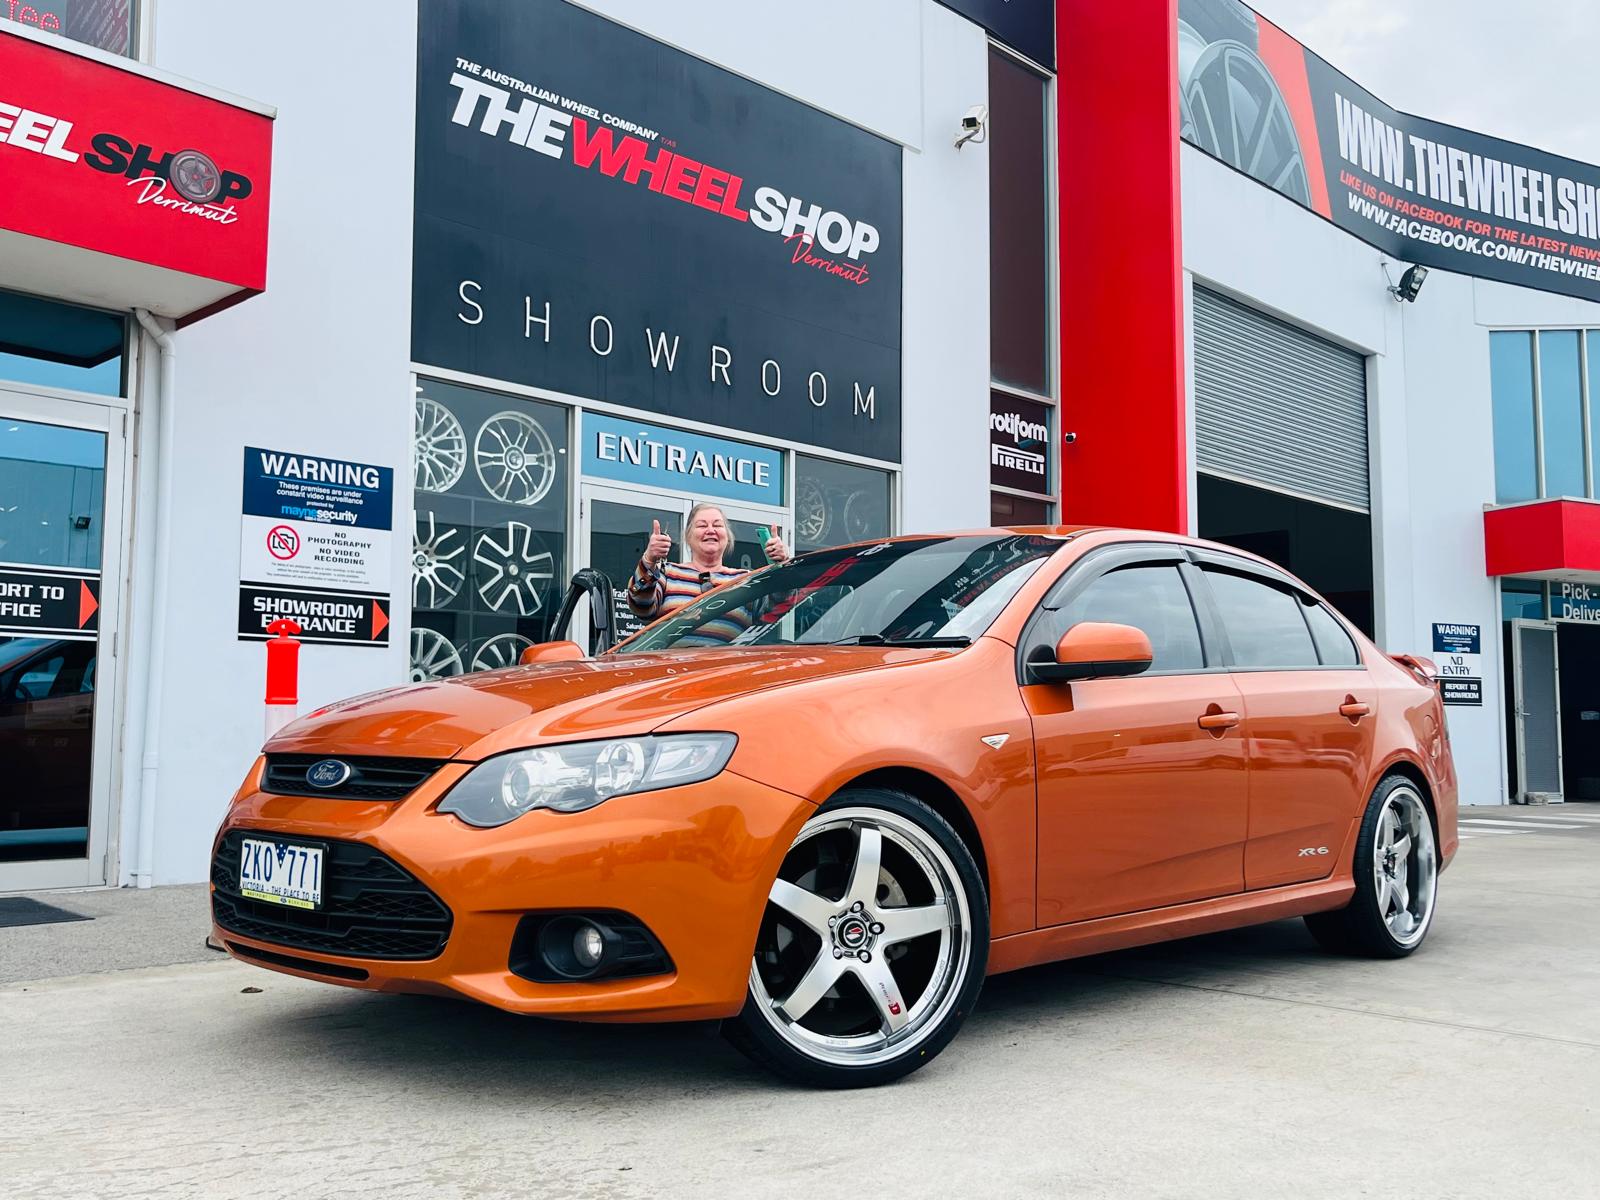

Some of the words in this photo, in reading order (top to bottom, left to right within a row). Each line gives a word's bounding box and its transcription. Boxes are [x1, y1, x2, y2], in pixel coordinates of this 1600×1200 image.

[456, 57, 482, 76] THE
[481, 67, 560, 106] AUSTRALIAN
[561, 97, 600, 120] WHEEL
[602, 113, 659, 141] COMPANY
[450, 72, 573, 160] THE
[573, 116, 749, 222] WHEEL
[750, 186, 880, 260] SHOP
[1335, 92, 1600, 240] WWW.THEWHEELSH
[126, 176, 238, 224] Derrimut
[1339, 170, 1362, 194] LIKE
[1362, 181, 1378, 200] US
[1379, 190, 1394, 208] ON
[1395, 198, 1464, 230] FACEBOOK
[1465, 220, 1491, 237] FOR
[1494, 226, 1519, 243] THE
[1520, 233, 1568, 254] LATEST
[784, 233, 869, 285] Derrimut
[990, 412, 1048, 442] rotiform
[597, 431, 770, 488] ENTRANCE
[991, 443, 1045, 475] PIRELLI
[260, 452, 380, 489] WARNING
[276, 489, 306, 499] constant
[306, 492, 325, 501] video
[325, 495, 364, 505] surveillance
[278, 481, 299, 491] These
[300, 484, 331, 495] premises
[331, 488, 342, 496] are
[343, 490, 363, 498] under
[307, 537, 372, 549] PHOTOGRAPHY
[314, 555, 365, 566] RECORDING
[334, 549, 361, 558] VIDEO
[40, 585, 65, 600] TO
[1562, 583, 1591, 601] Pick
[0, 601, 41, 618] FICE
[253, 596, 364, 619] SHOWROOM
[261, 613, 356, 634] ERANCE
[1436, 624, 1477, 636] WARNING
[1442, 665, 1472, 676] ENTRY
[1451, 656, 1463, 666] NO
[1444, 691, 1480, 699] SHOWROOM
[1445, 683, 1468, 691] REPORT
[313, 761, 340, 781] Ford
[1298, 846, 1329, 857] XR6
[242, 842, 273, 882] ZKO
[288, 849, 318, 891] 771
[242, 881, 265, 893] VICTORIA
[272, 886, 282, 896] THE
[284, 888, 300, 900] PLACE
[303, 892, 309, 901] TO
[312, 893, 320, 902] BE
